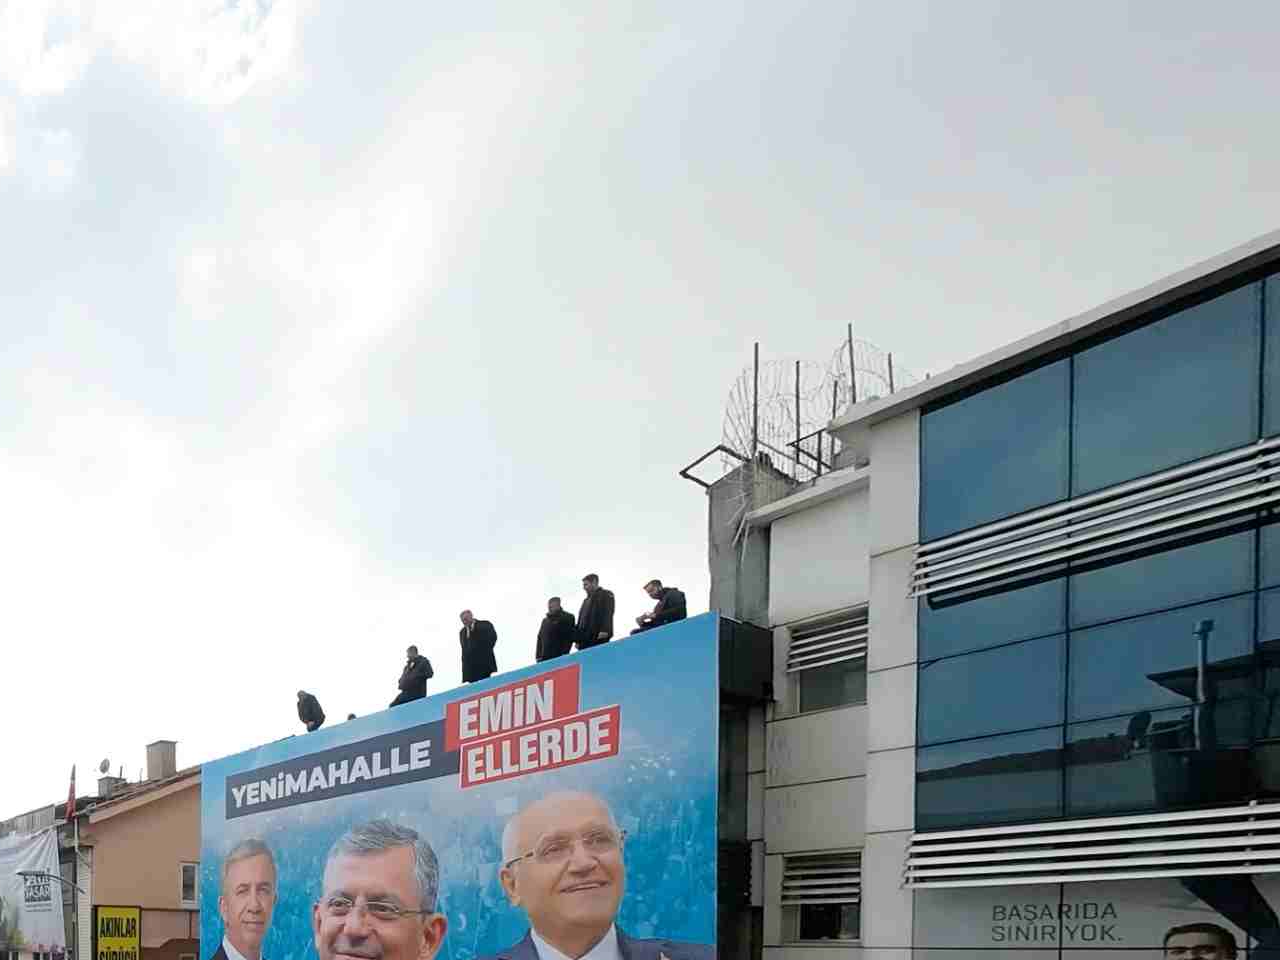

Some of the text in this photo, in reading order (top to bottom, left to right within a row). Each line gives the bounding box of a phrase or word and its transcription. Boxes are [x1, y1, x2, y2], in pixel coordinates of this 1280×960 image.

[468, 714, 610, 782] ELLERDE
[100, 917, 137, 938] AKINLAR
[991, 924, 1125, 942] SINIR YOK.
